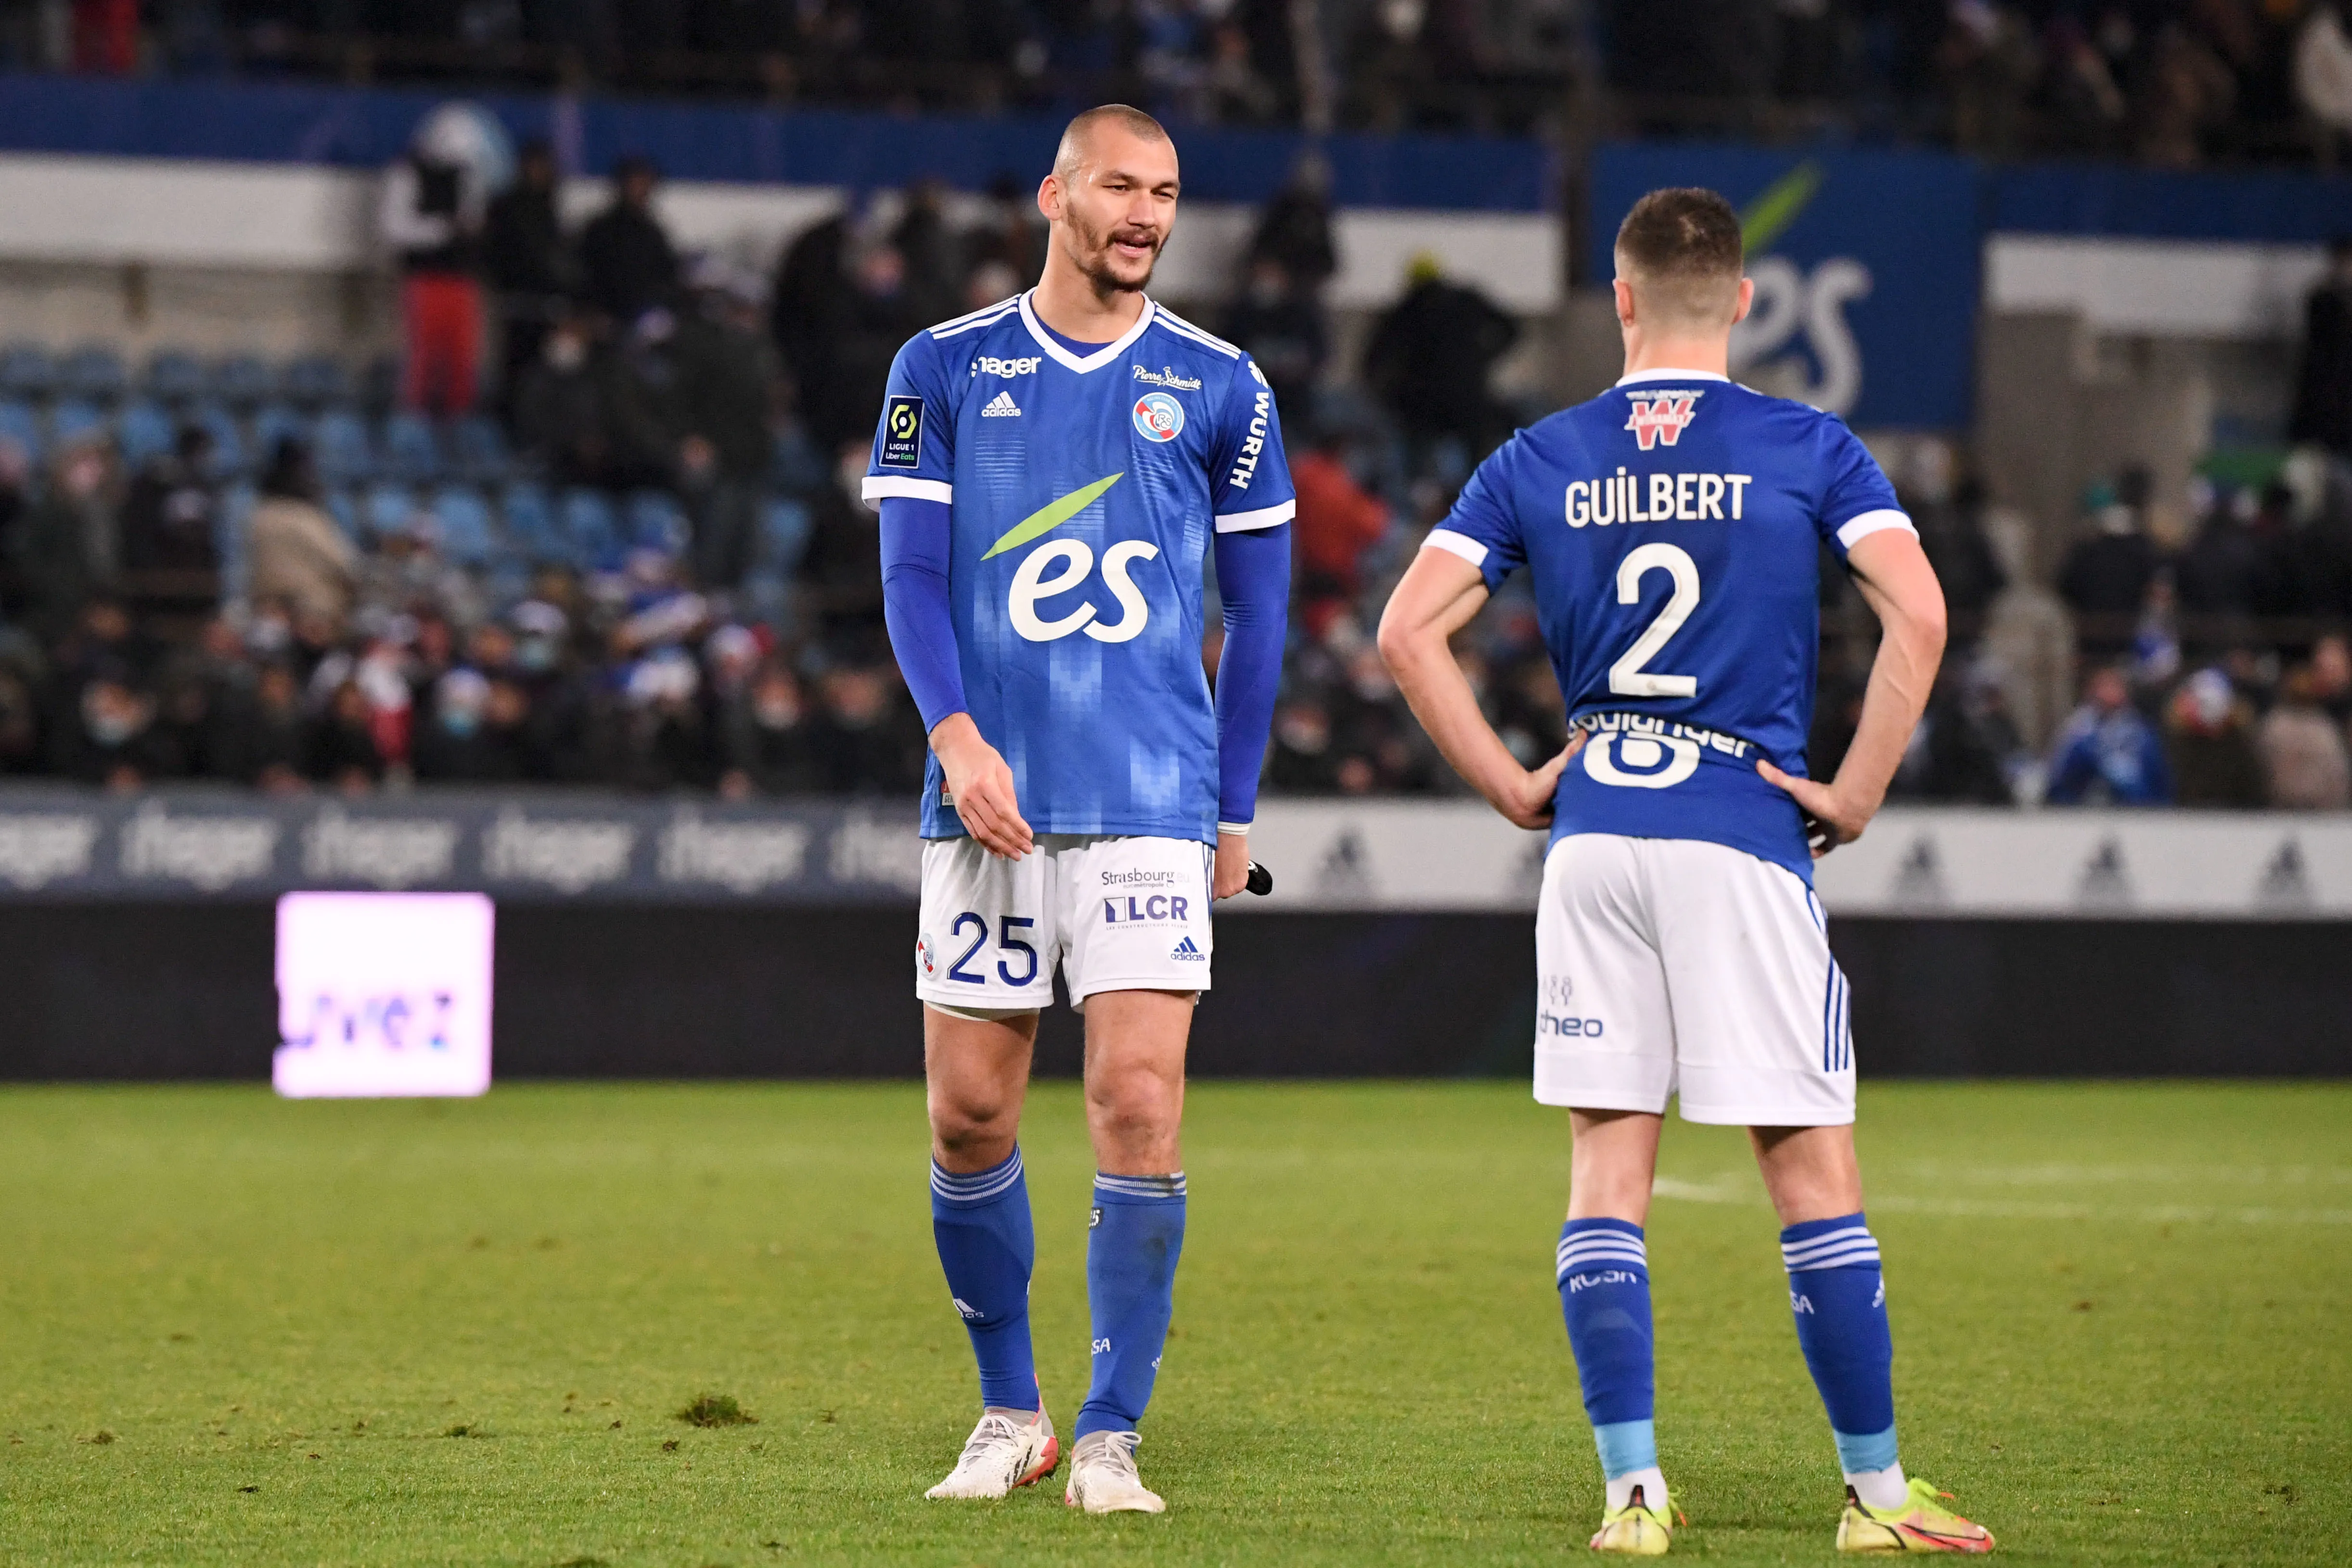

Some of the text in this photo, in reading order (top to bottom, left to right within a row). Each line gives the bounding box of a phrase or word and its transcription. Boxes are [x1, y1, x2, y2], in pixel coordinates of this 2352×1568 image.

[1133, 365, 1202, 390] Pierre Schmidt
[981, 408, 1021, 417] adidas
[1230, 392, 1269, 489] WÜRTH
[1009, 539, 1159, 643] es
[1608, 542, 1700, 697] 2
[1102, 868, 1174, 888] Strasbourg
[1129, 895, 1187, 921] LCR
[947, 912, 1037, 987] 25
[1170, 952, 1205, 961] adidas
